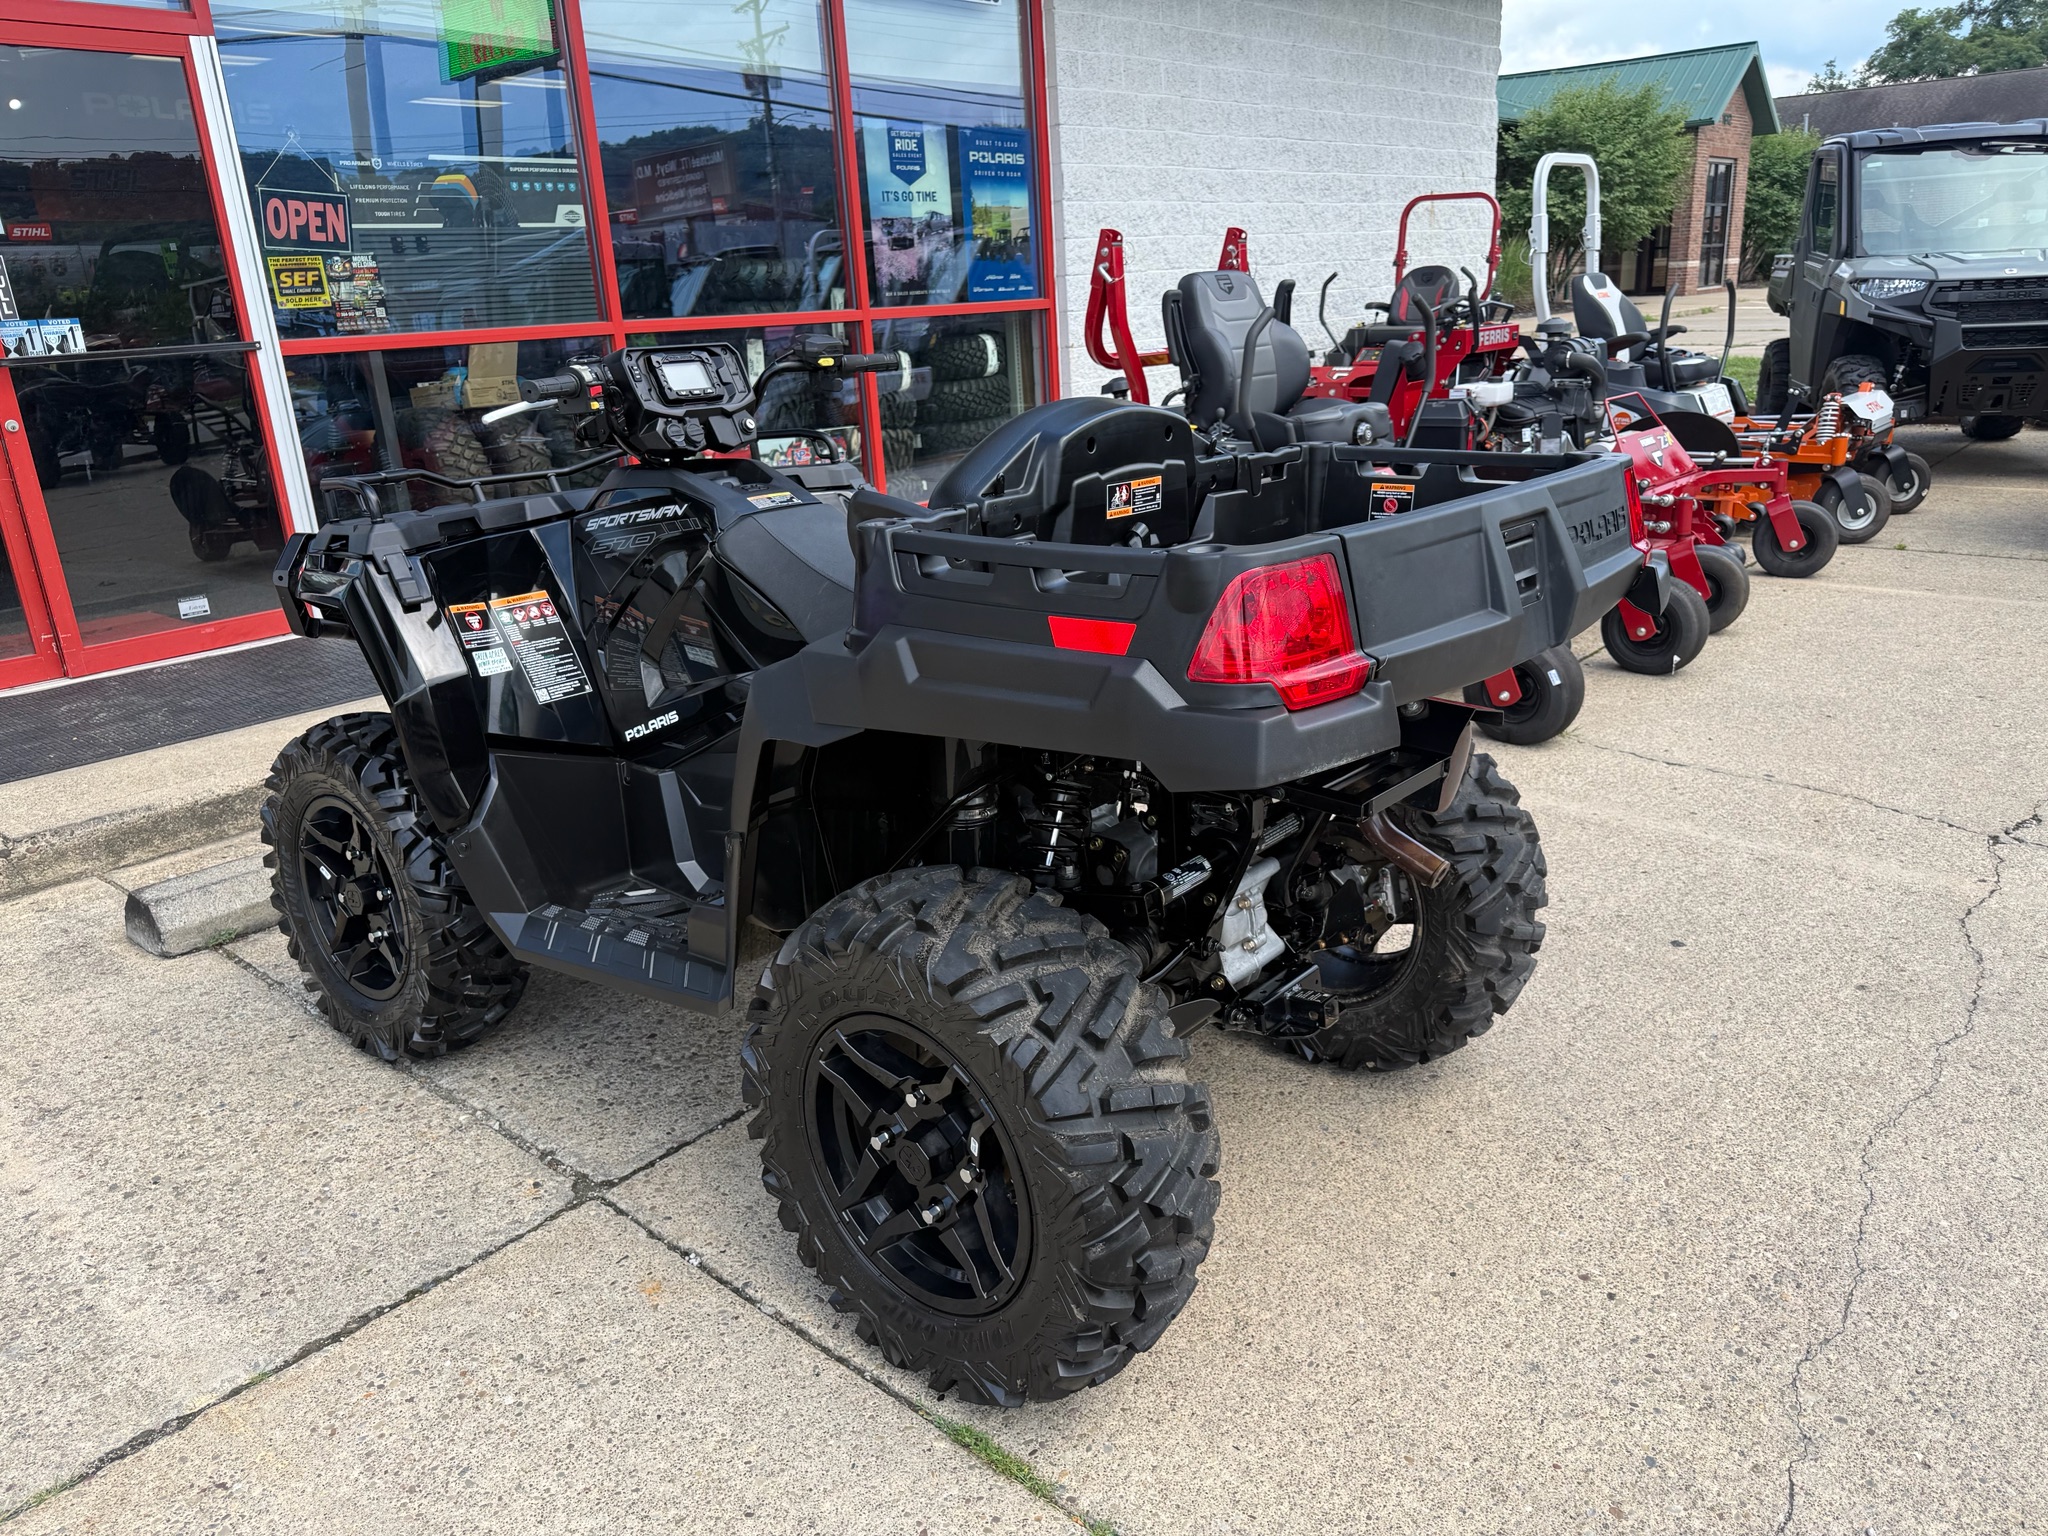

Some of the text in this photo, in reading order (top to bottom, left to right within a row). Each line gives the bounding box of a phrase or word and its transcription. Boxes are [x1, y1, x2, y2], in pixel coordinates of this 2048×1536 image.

[82, 92, 274, 125] POLAIS
[895, 138, 919, 151] RIDE
[969, 151, 1025, 165] POLARIS
[881, 190, 938, 203] IT'S GO TIME
[266, 197, 347, 243] OPEN
[619, 213, 636, 222] STIHL
[12, 227, 49, 236] STIHL
[279, 271, 319, 288] SEF
[1976, 290, 2043, 300] POLARIS
[1478, 327, 1511, 347] FERRIS
[1866, 400, 1884, 413] STIHL
[585, 504, 688, 531] SPORTSMAN
[1566, 505, 1627, 546] POLARIS
[591, 531, 656, 555] 570
[624, 710, 679, 742] POLARIS
[818, 985, 934, 1028] DURO
